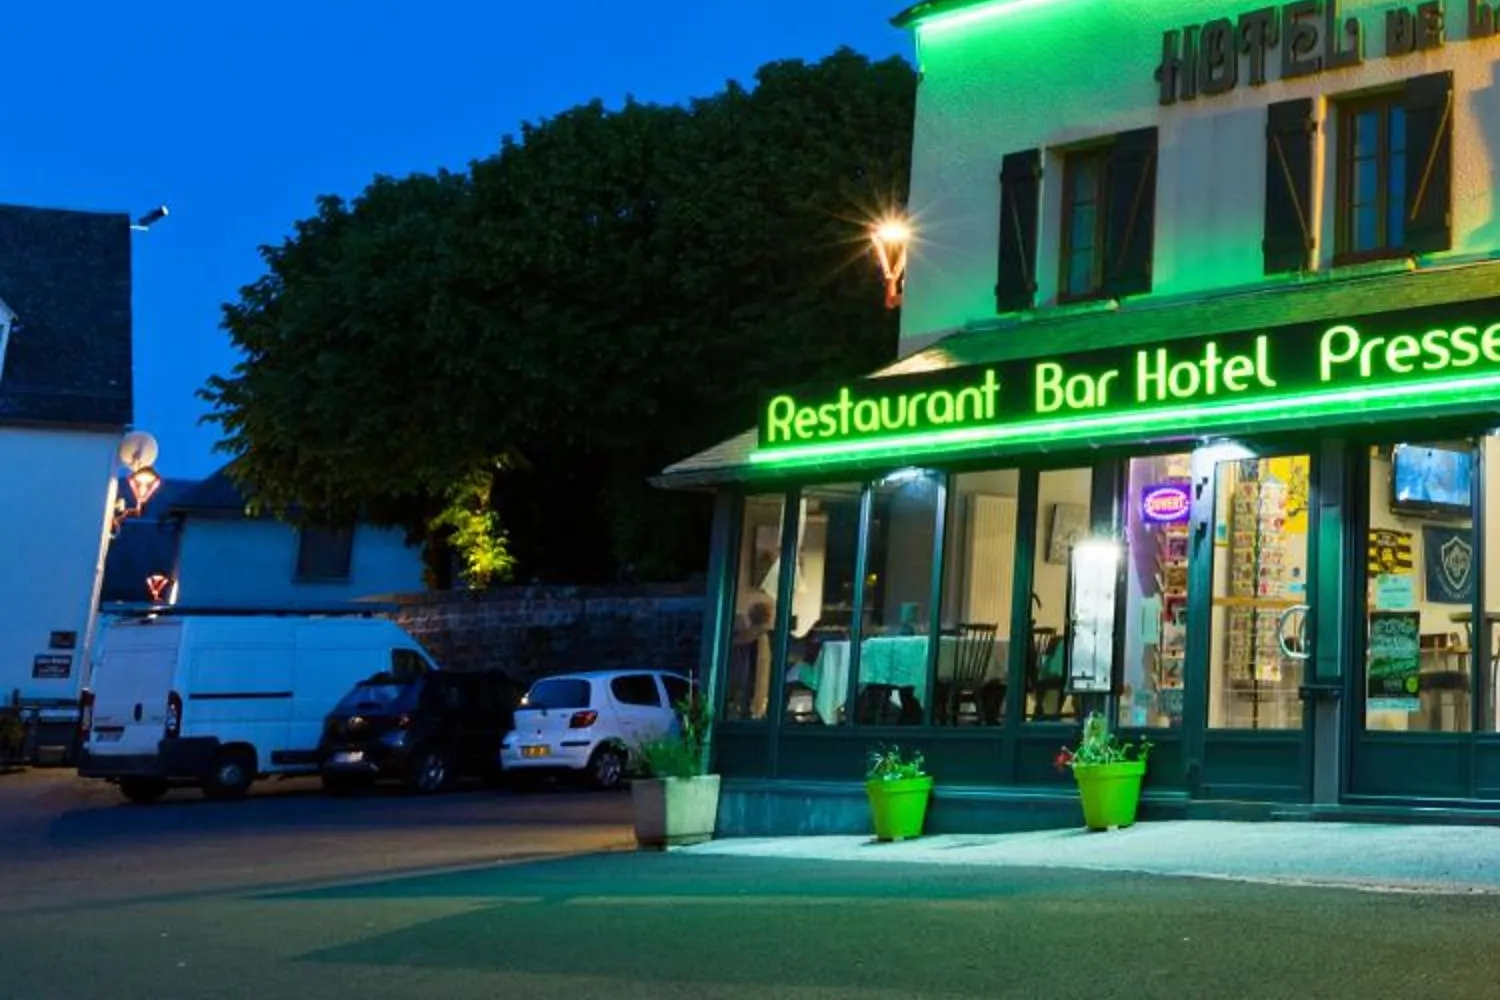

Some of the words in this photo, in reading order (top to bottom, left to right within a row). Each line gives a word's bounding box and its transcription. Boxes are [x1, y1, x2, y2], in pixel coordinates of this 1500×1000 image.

[1386, 0, 1446, 57] DE
[767, 368, 1001, 442] Restaurant
[1035, 362, 1119, 414] Bar
[1136, 334, 1277, 402] Hotel
